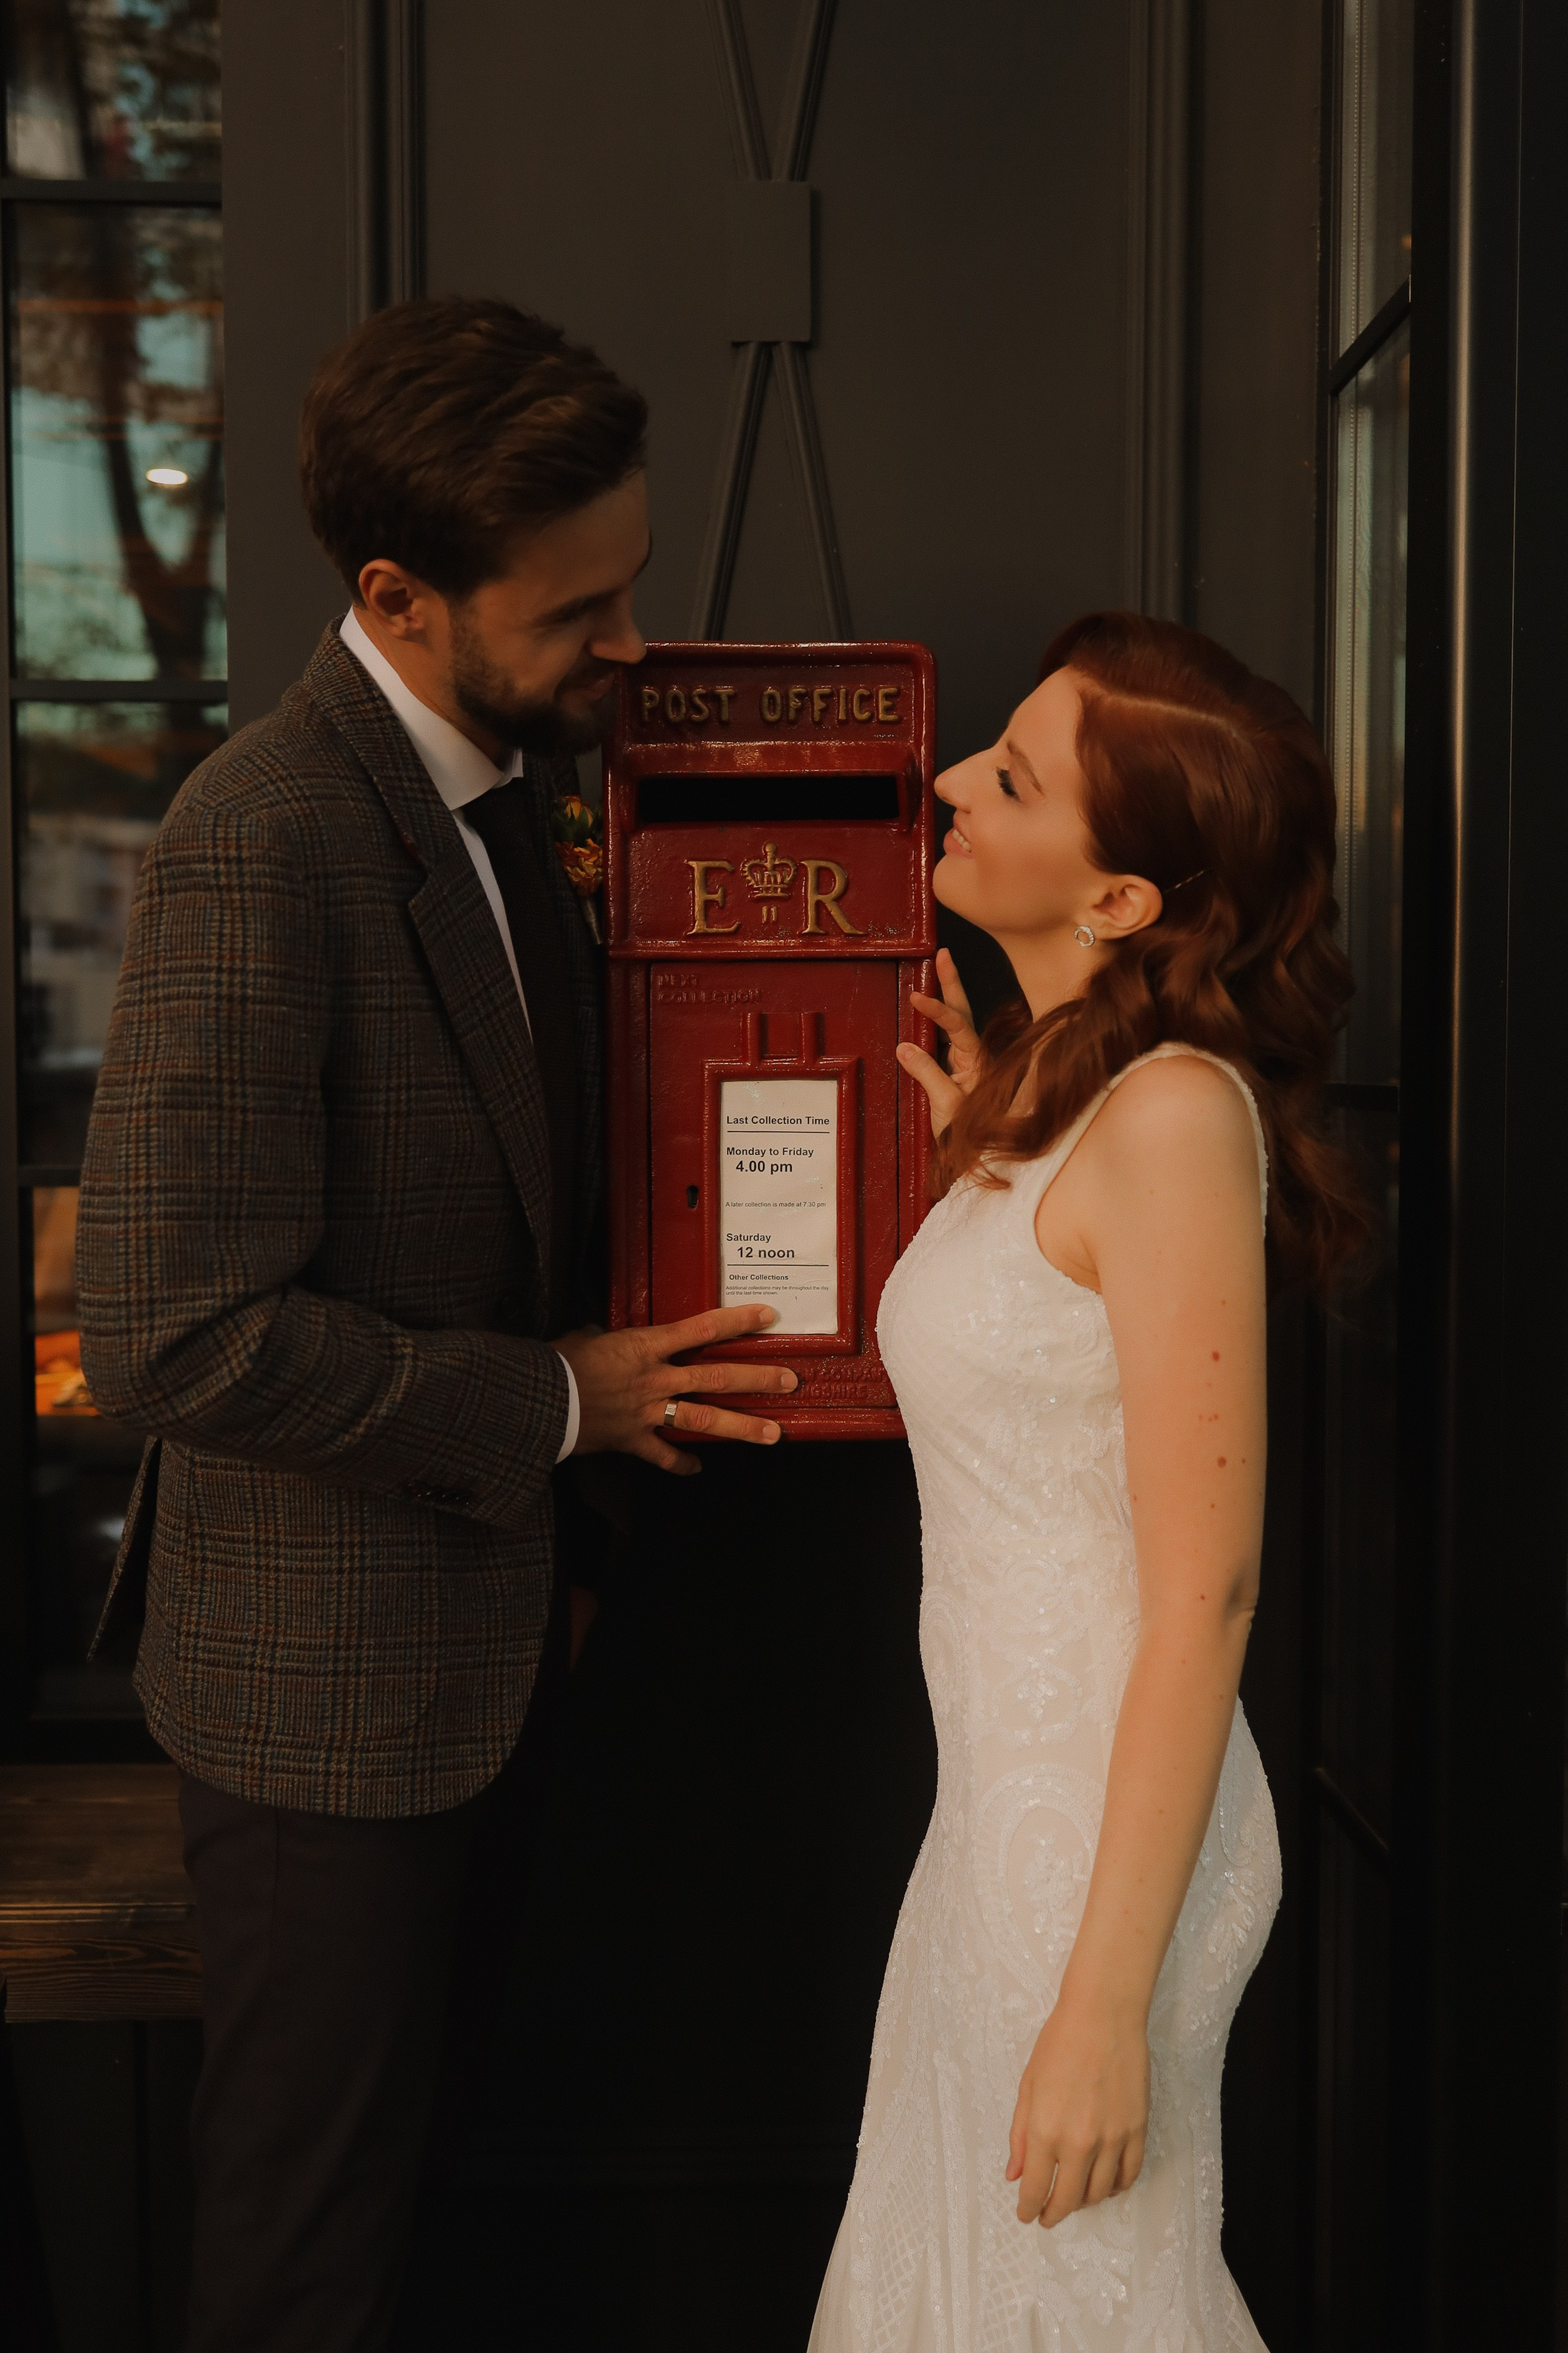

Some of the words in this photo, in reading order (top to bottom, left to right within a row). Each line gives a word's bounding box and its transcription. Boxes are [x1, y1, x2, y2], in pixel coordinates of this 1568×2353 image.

[641, 687, 736, 723] POST
[761, 686, 901, 724] OFFICE
[687, 860, 741, 935] E
[801, 860, 864, 935] R
[657, 989, 763, 1004] COLLECTION
[726, 1116, 748, 1125] Last
[751, 1116, 802, 1125] Collection
[805, 1116, 830, 1125] Time
[726, 1147, 766, 1158] Monday
[769, 1148, 779, 1156] to
[782, 1147, 814, 1158] Friday
[736, 1161, 766, 1172] 4.00
[771, 1162, 792, 1175] pm
[726, 1233, 771, 1243] Saturday
[737, 1247, 753, 1258] 12
[758, 1249, 795, 1258] noon
